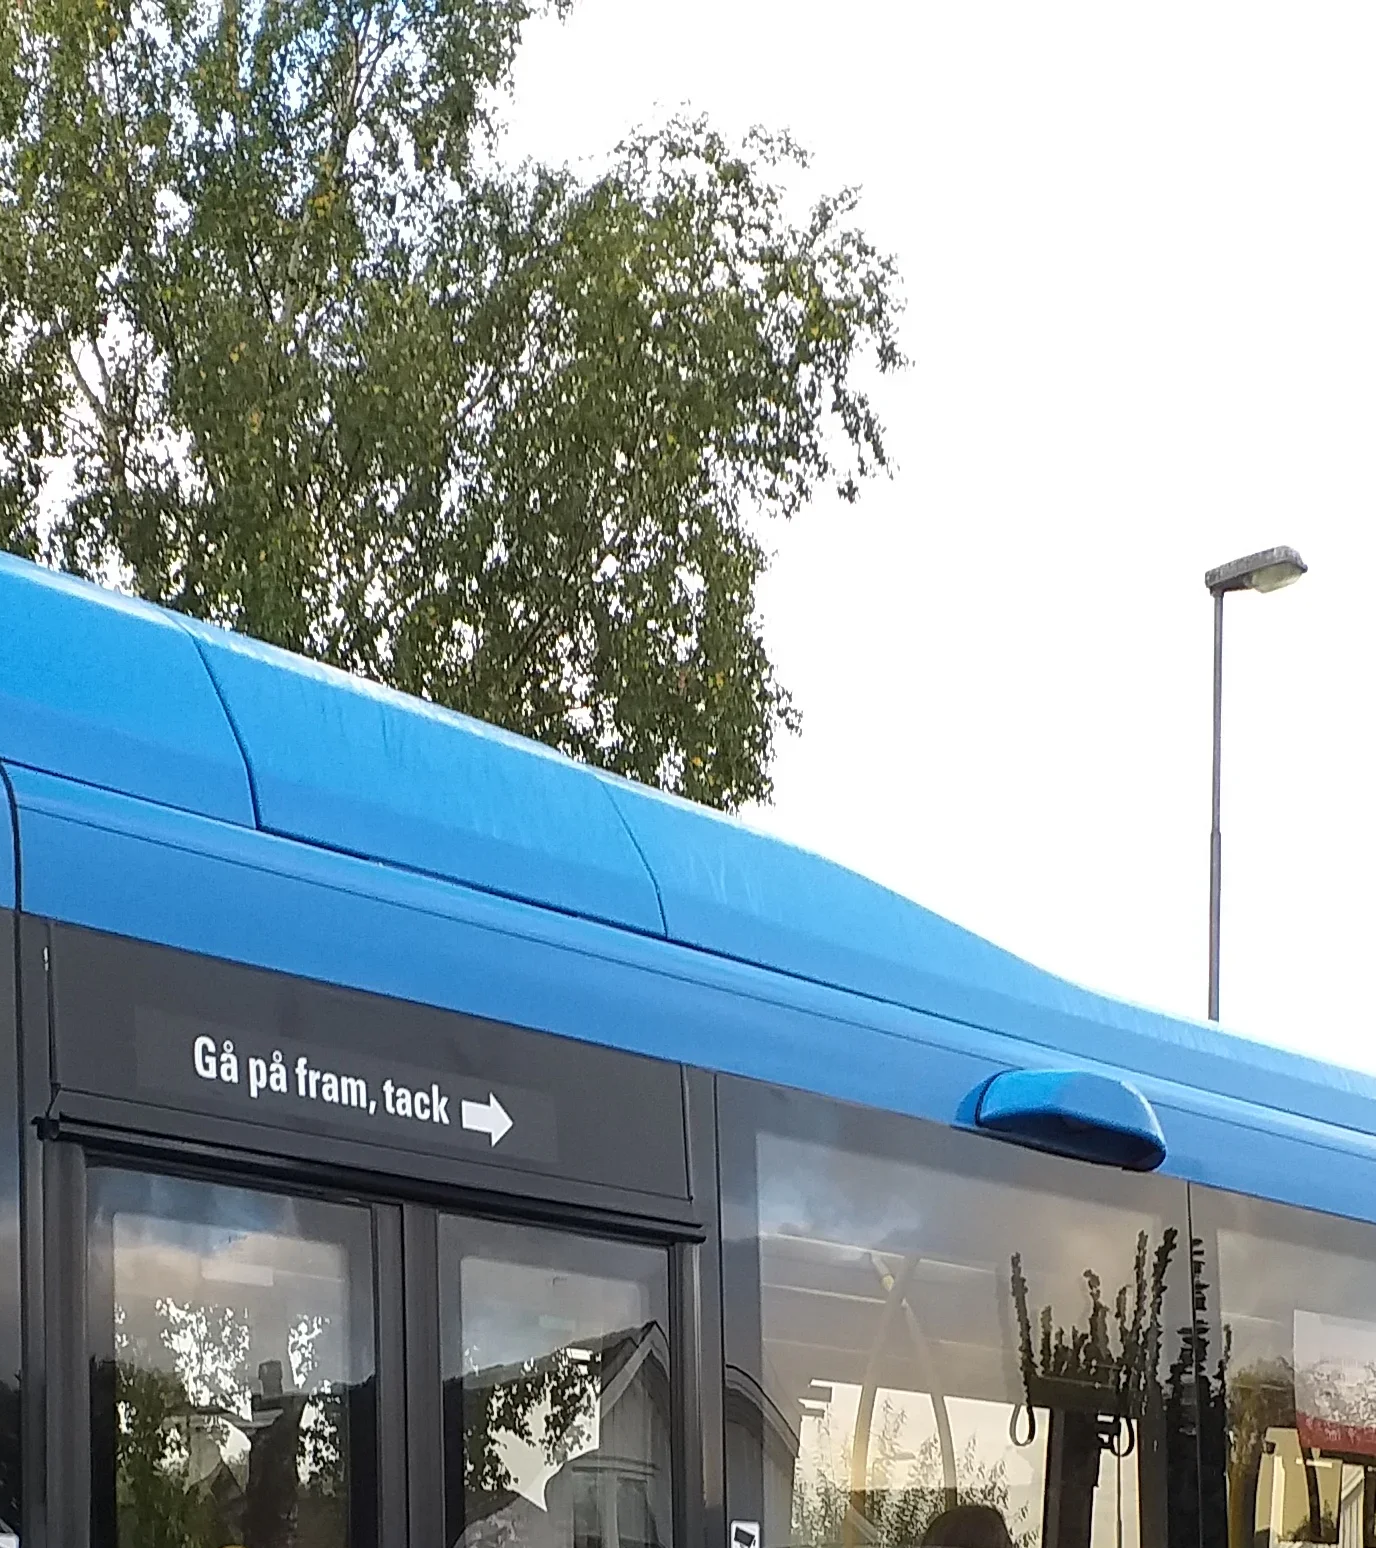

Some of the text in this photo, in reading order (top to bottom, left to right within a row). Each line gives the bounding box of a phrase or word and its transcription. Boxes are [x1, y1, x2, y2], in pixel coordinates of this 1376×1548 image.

[194, 1035, 449, 1124] Gå på fram, tack
